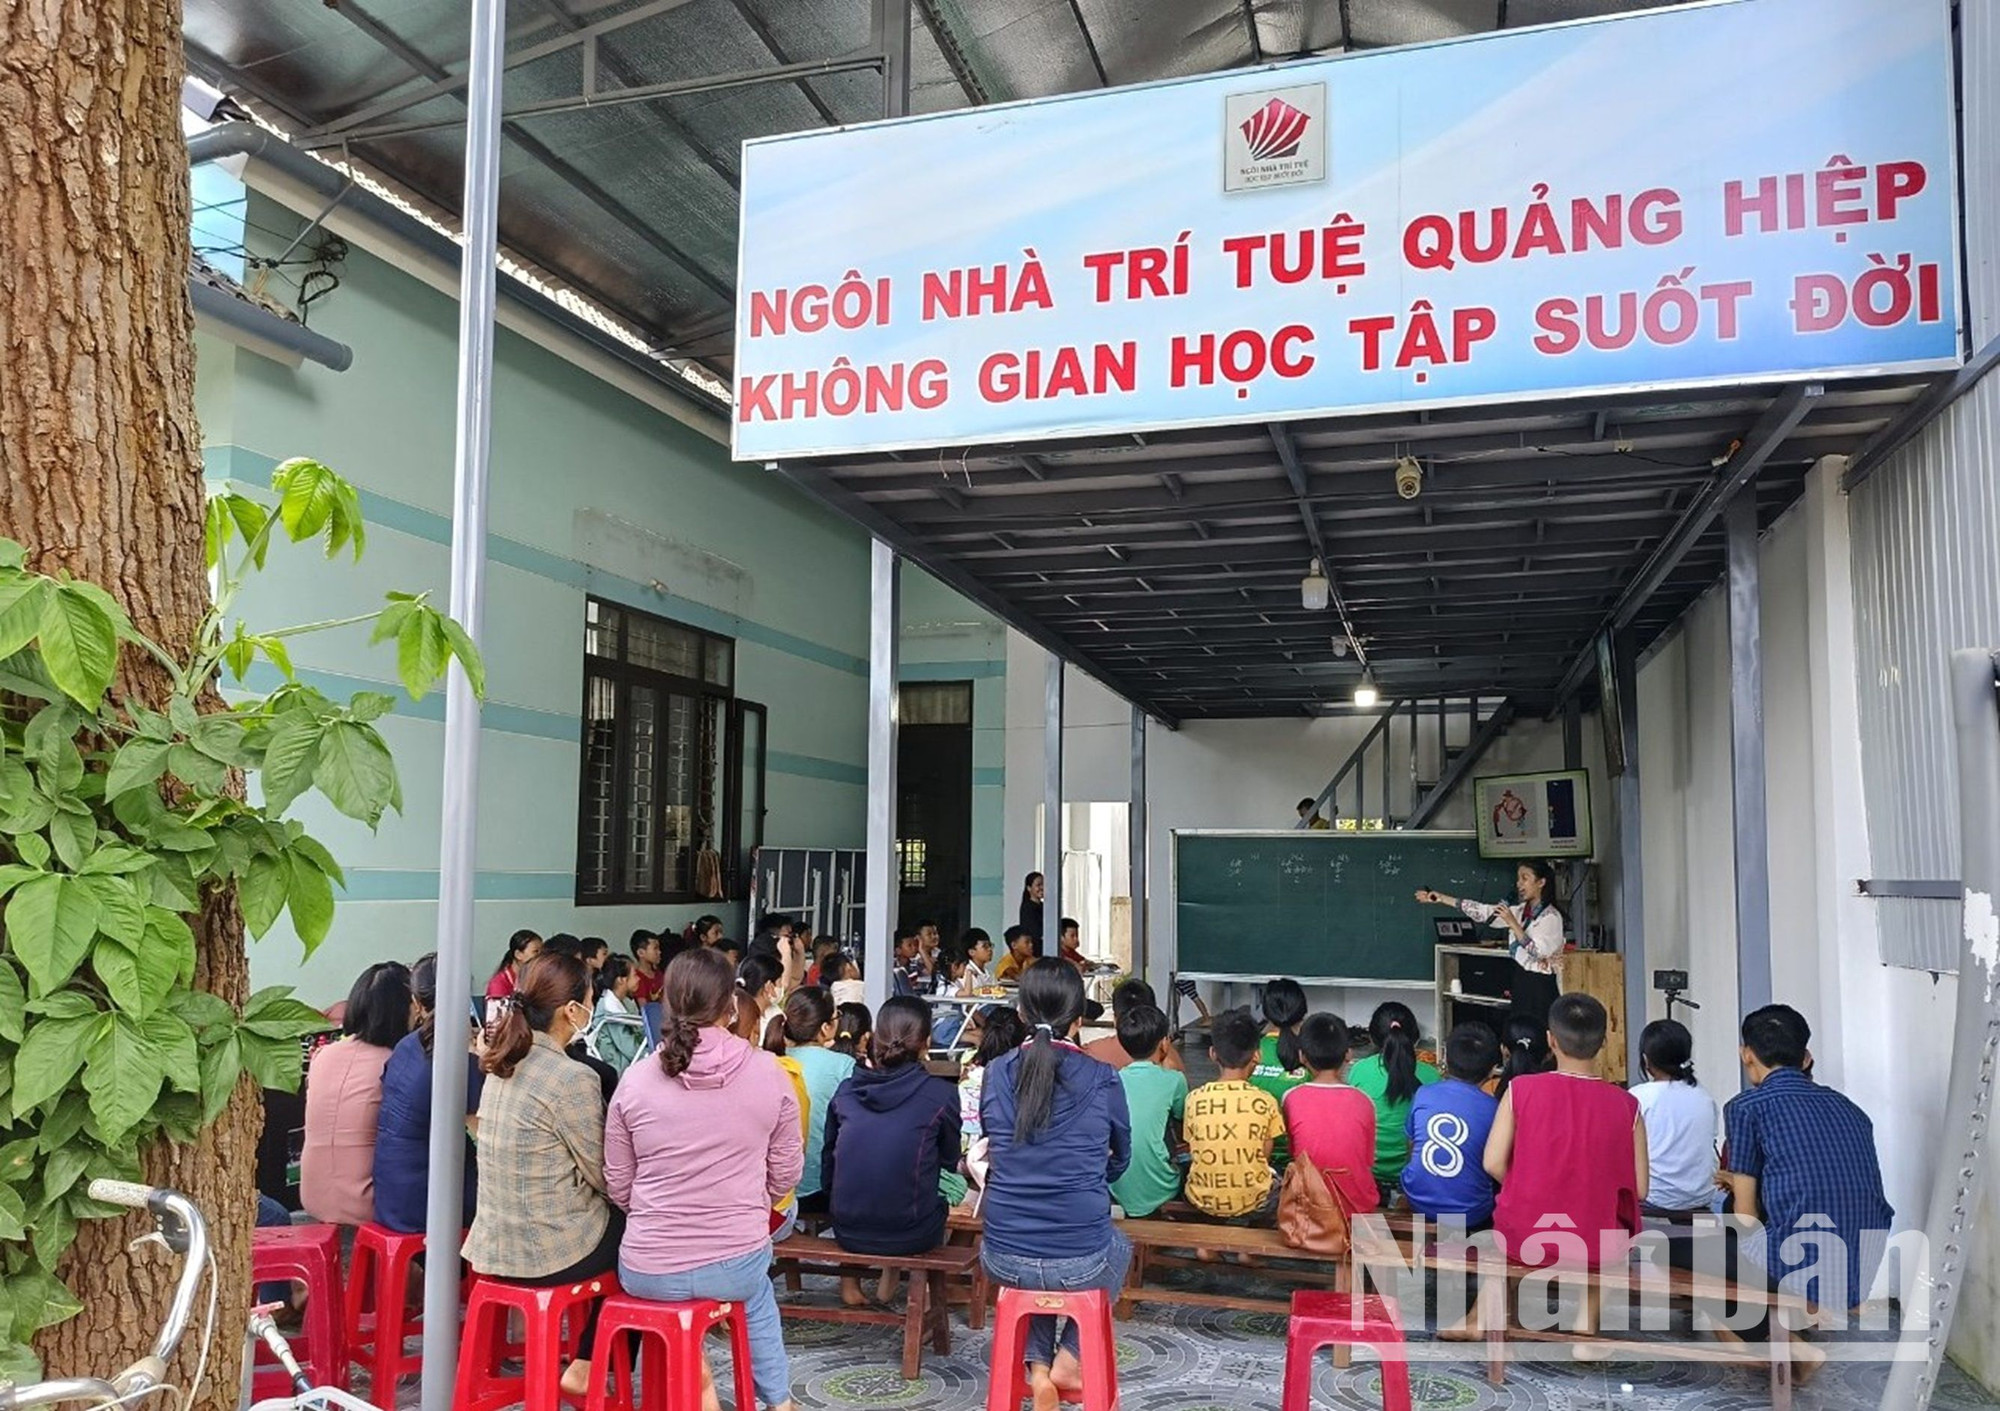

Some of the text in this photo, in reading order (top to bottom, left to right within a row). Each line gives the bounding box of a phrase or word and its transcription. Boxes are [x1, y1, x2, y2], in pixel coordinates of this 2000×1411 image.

[750, 154, 1927, 338] NGÔI NHÀ TRÍ TUỆ QUẢNG HIỆP
[739, 252, 1940, 423] KHÔNG GIAN HỌC TẬP SUỐT ĐỜI
[1421, 1113, 1470, 1178] 8
